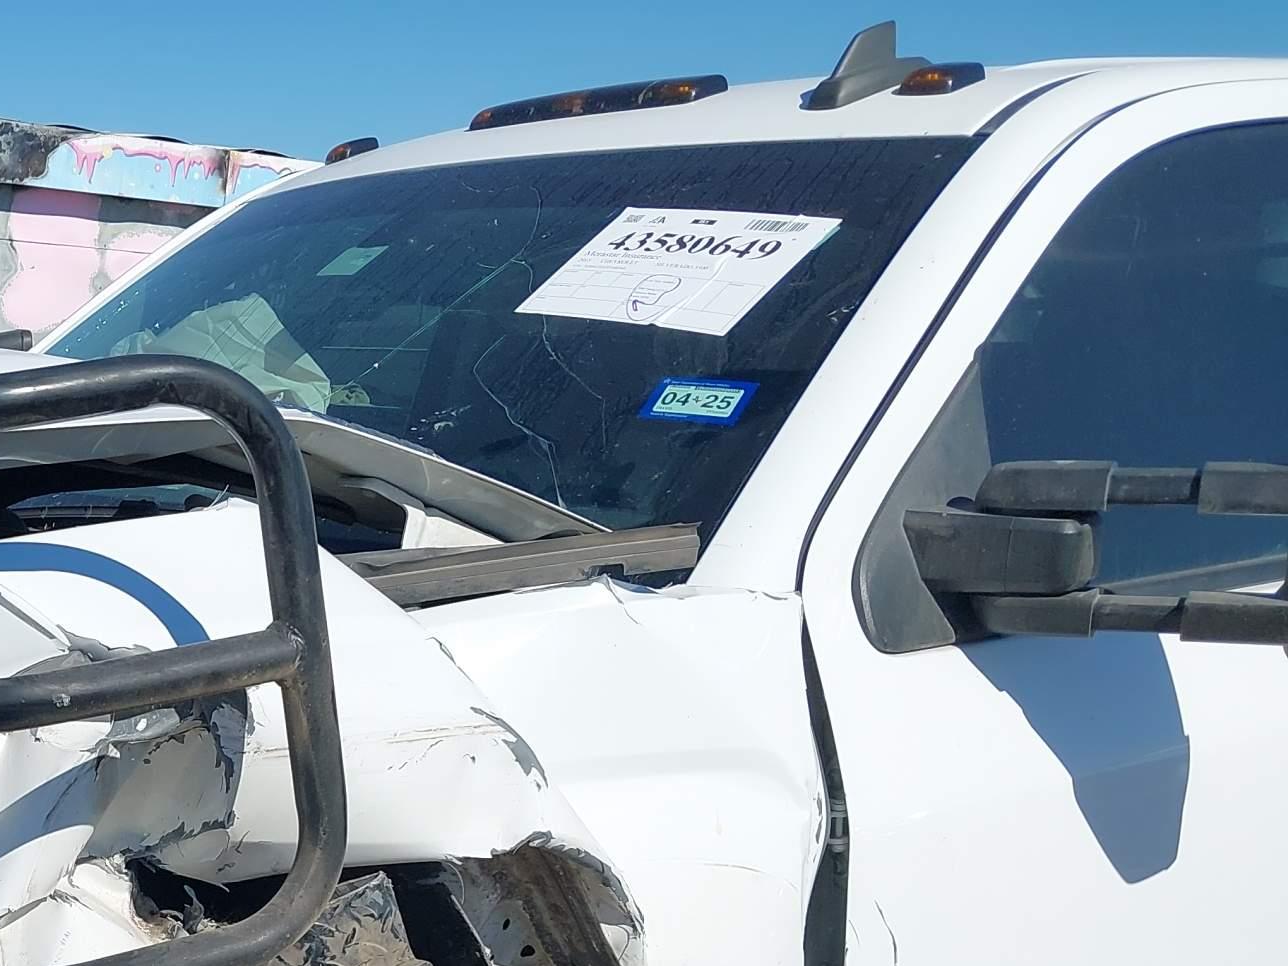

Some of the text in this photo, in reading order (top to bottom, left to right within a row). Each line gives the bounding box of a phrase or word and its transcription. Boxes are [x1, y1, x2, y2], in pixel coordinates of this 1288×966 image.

[608, 231, 783, 260] 43580649
[661, 391, 735, 410] 04 25
